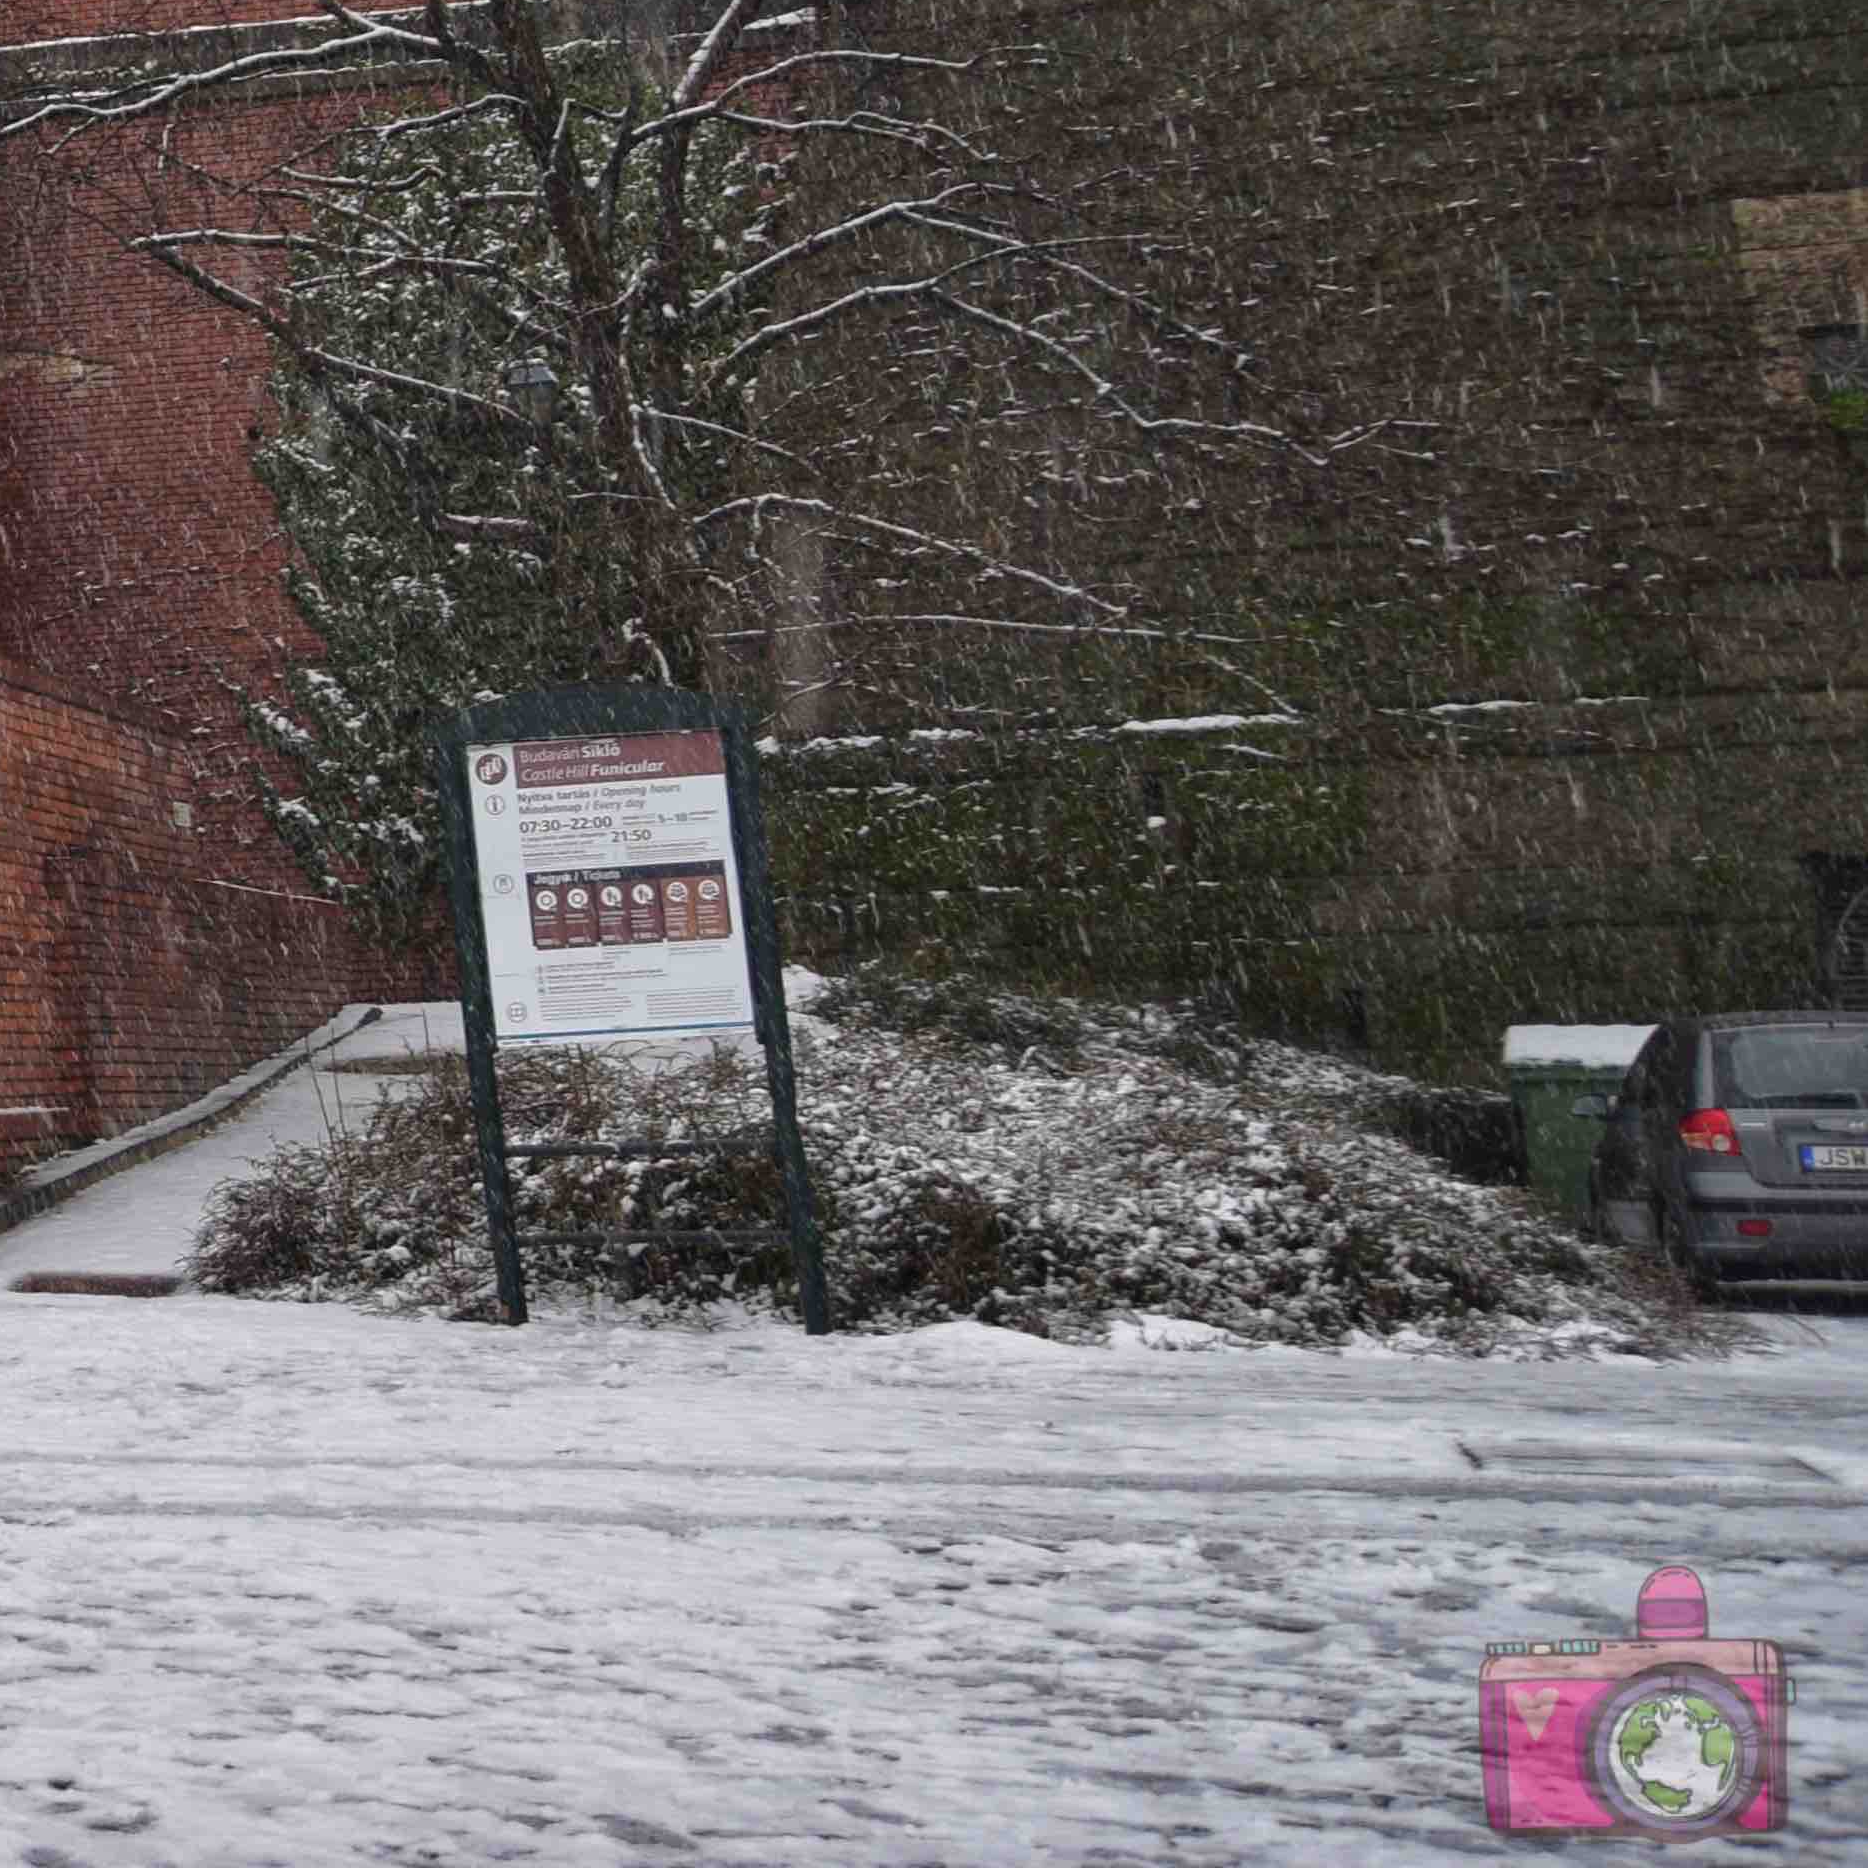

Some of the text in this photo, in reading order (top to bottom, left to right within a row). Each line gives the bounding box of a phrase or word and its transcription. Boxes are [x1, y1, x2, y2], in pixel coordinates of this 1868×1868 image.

[519, 743, 622, 763] Budavári Sikló
[521, 760, 665, 782] Castle Hill Funicular
[601, 786, 647, 798] Opening
[593, 800, 622, 811] Every
[624, 798, 645, 810] day
[611, 829, 652, 843] 21:50
